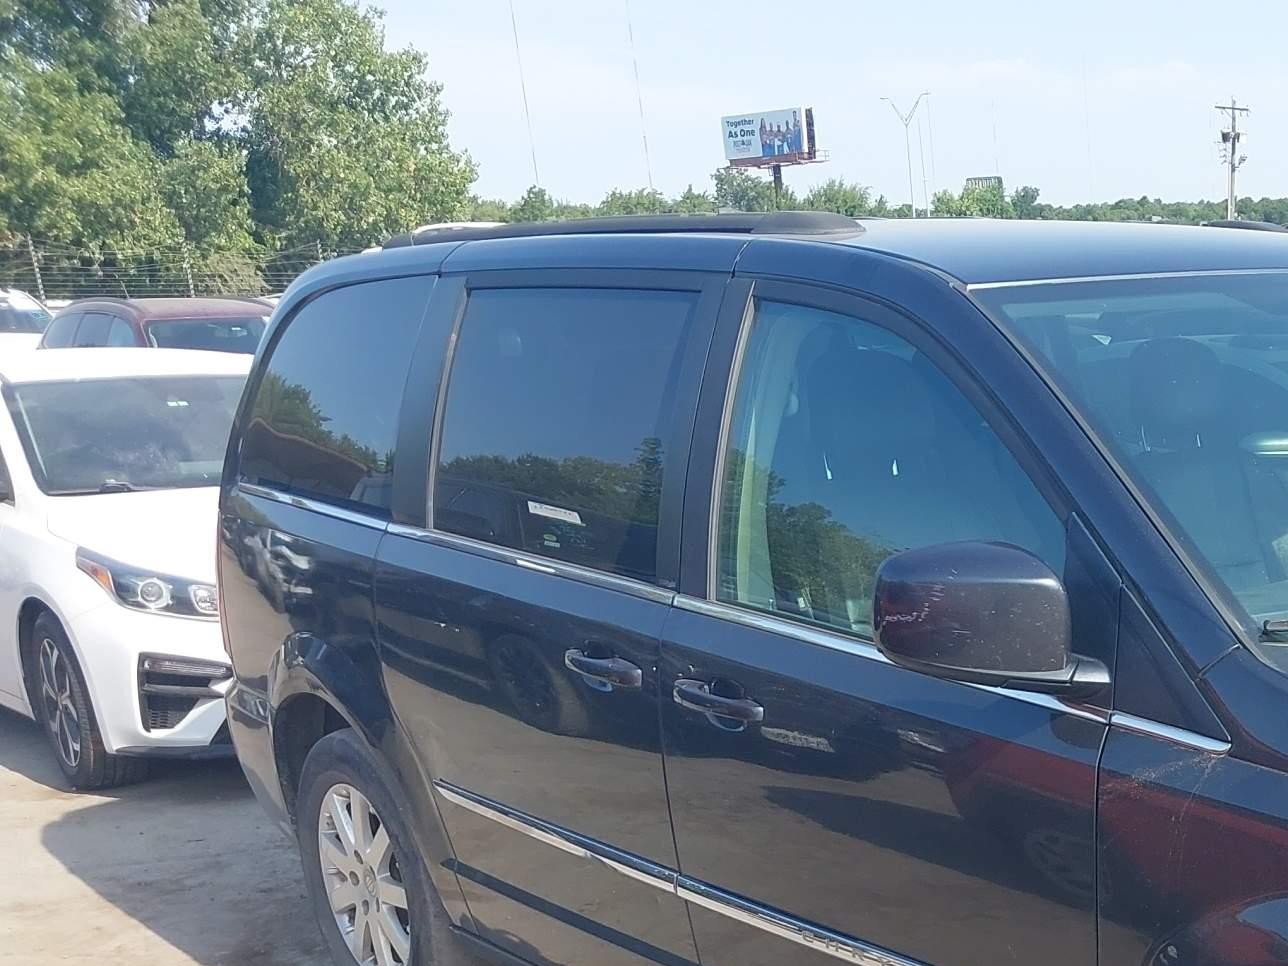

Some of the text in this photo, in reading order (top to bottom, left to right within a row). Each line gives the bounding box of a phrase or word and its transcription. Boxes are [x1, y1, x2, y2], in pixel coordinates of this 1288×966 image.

[726, 118, 754, 128] Together
[728, 129, 756, 139] As One
